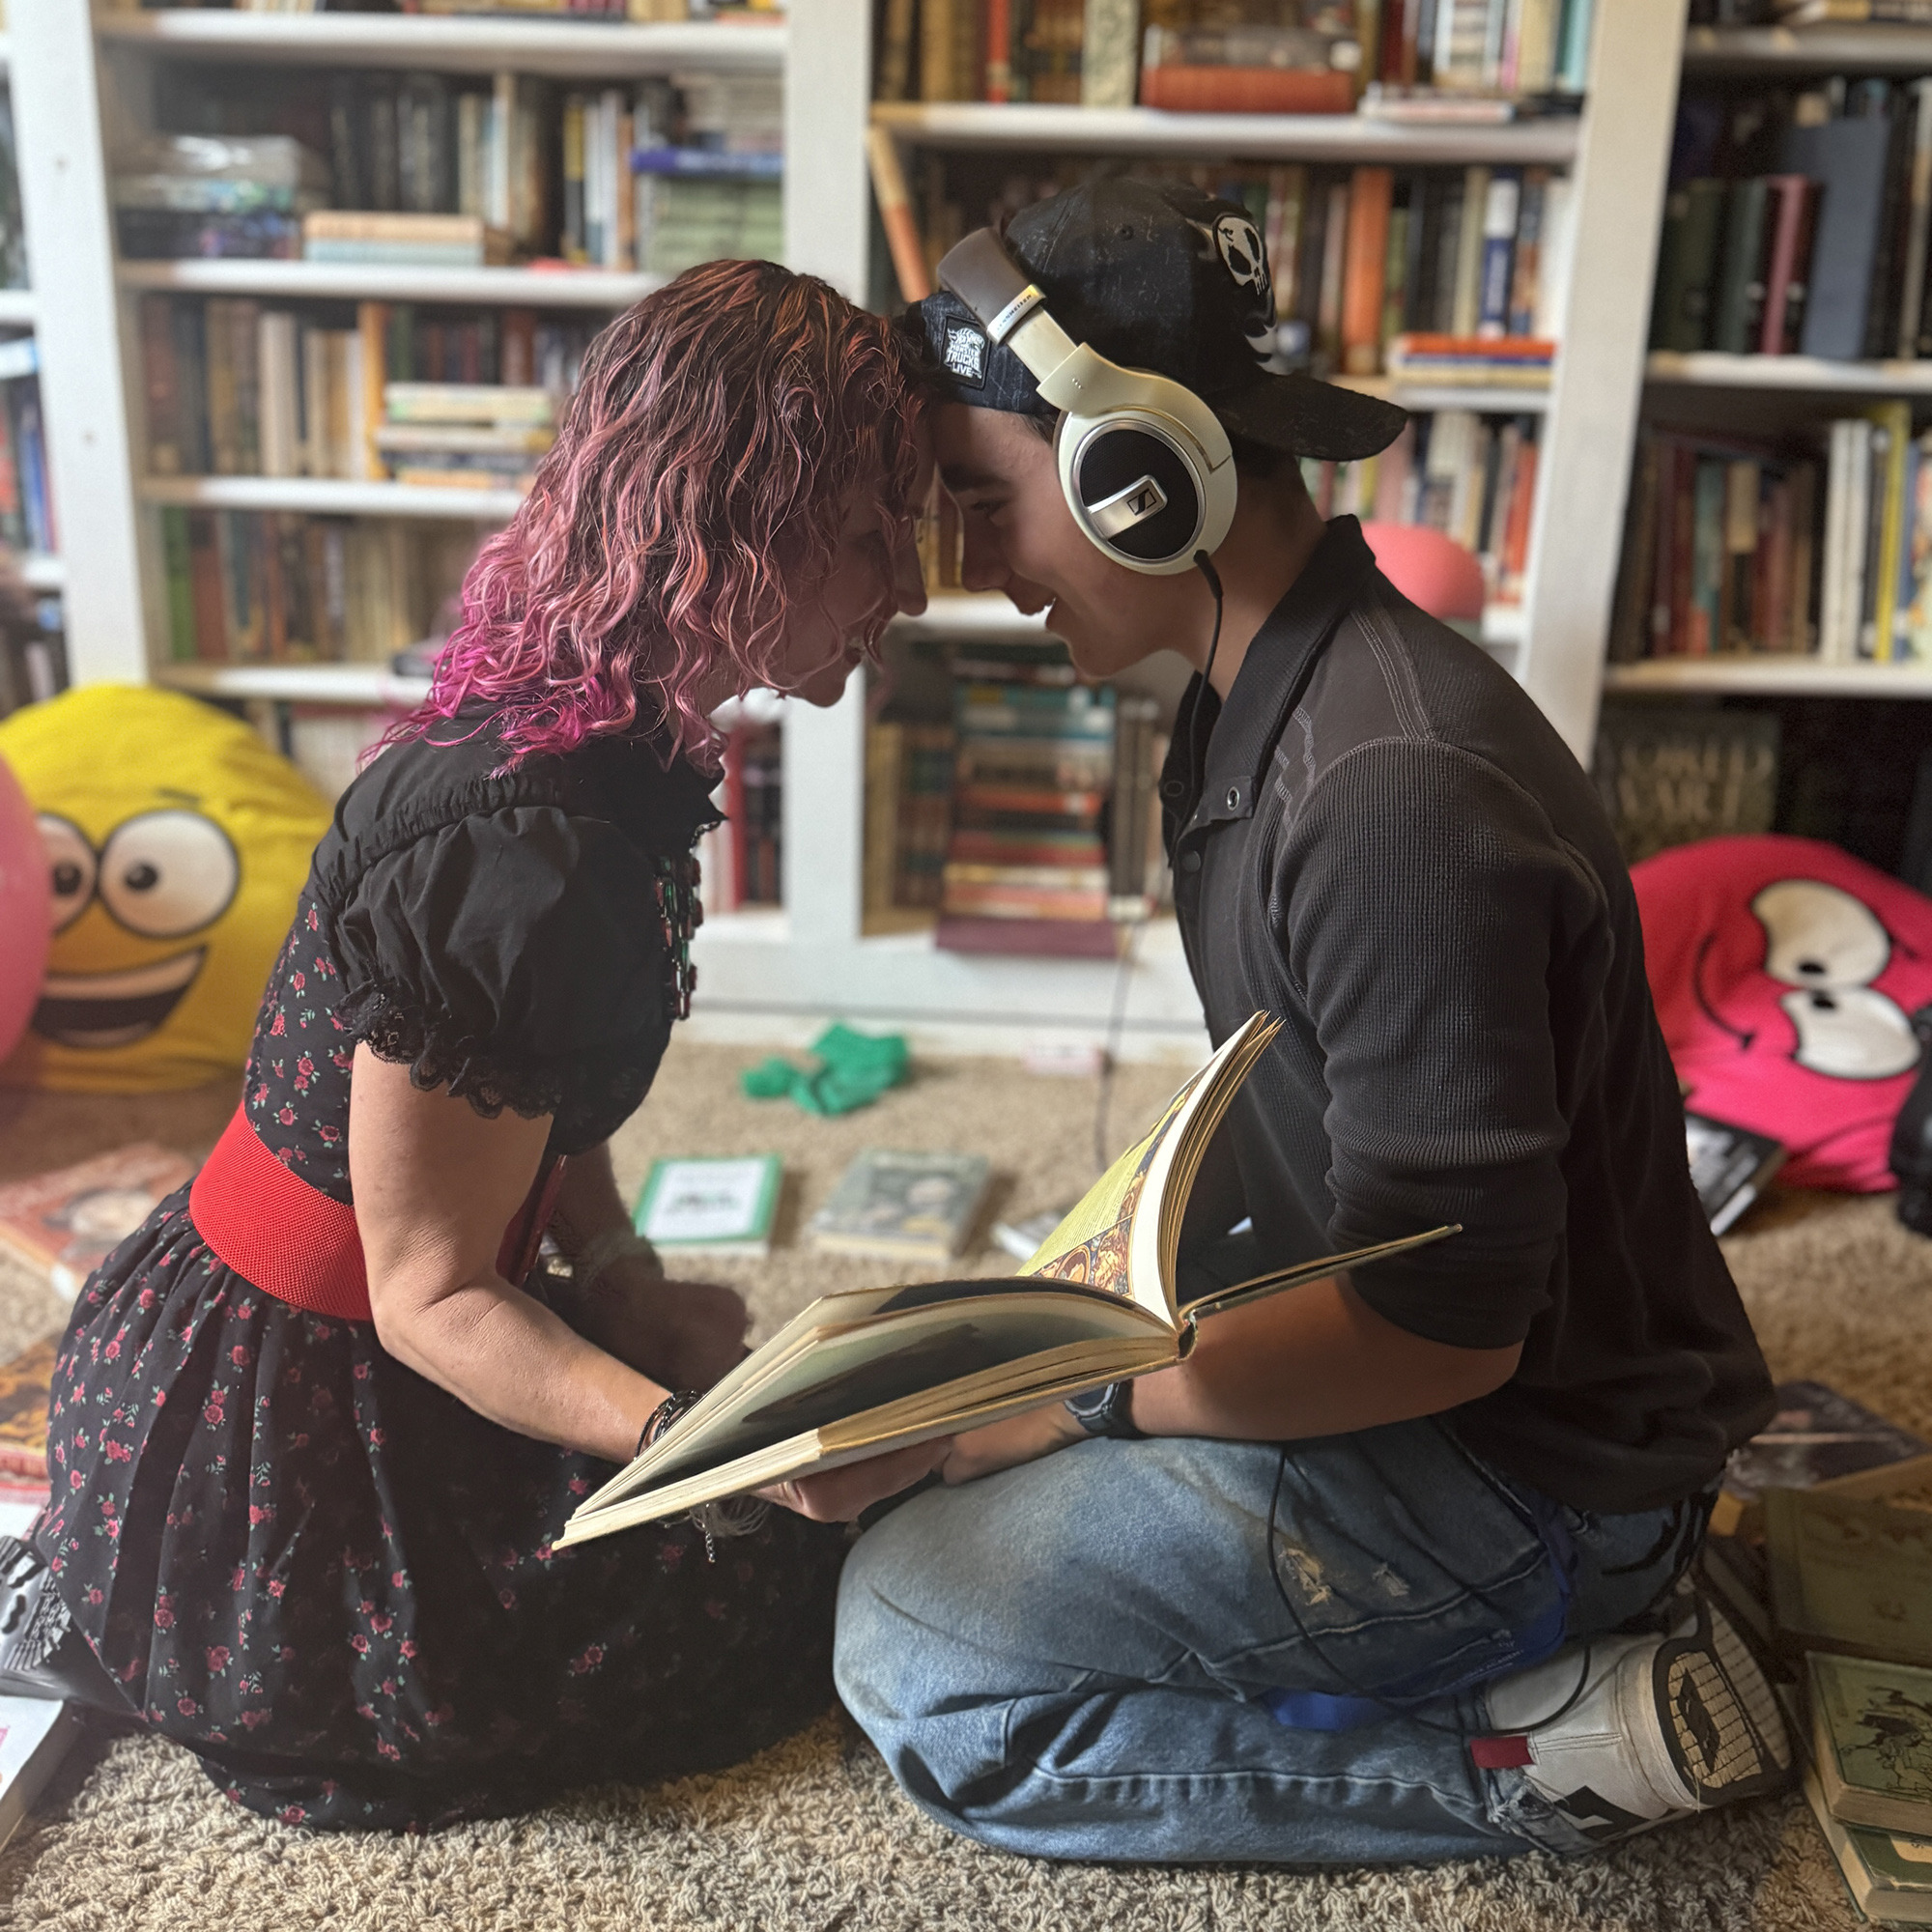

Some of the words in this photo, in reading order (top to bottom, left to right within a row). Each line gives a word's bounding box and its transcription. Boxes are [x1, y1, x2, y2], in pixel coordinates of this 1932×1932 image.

[996, 294, 1033, 331] NNHEISER
[946, 350, 980, 371] TRUCKS
[952, 362, 974, 378] LIVE
